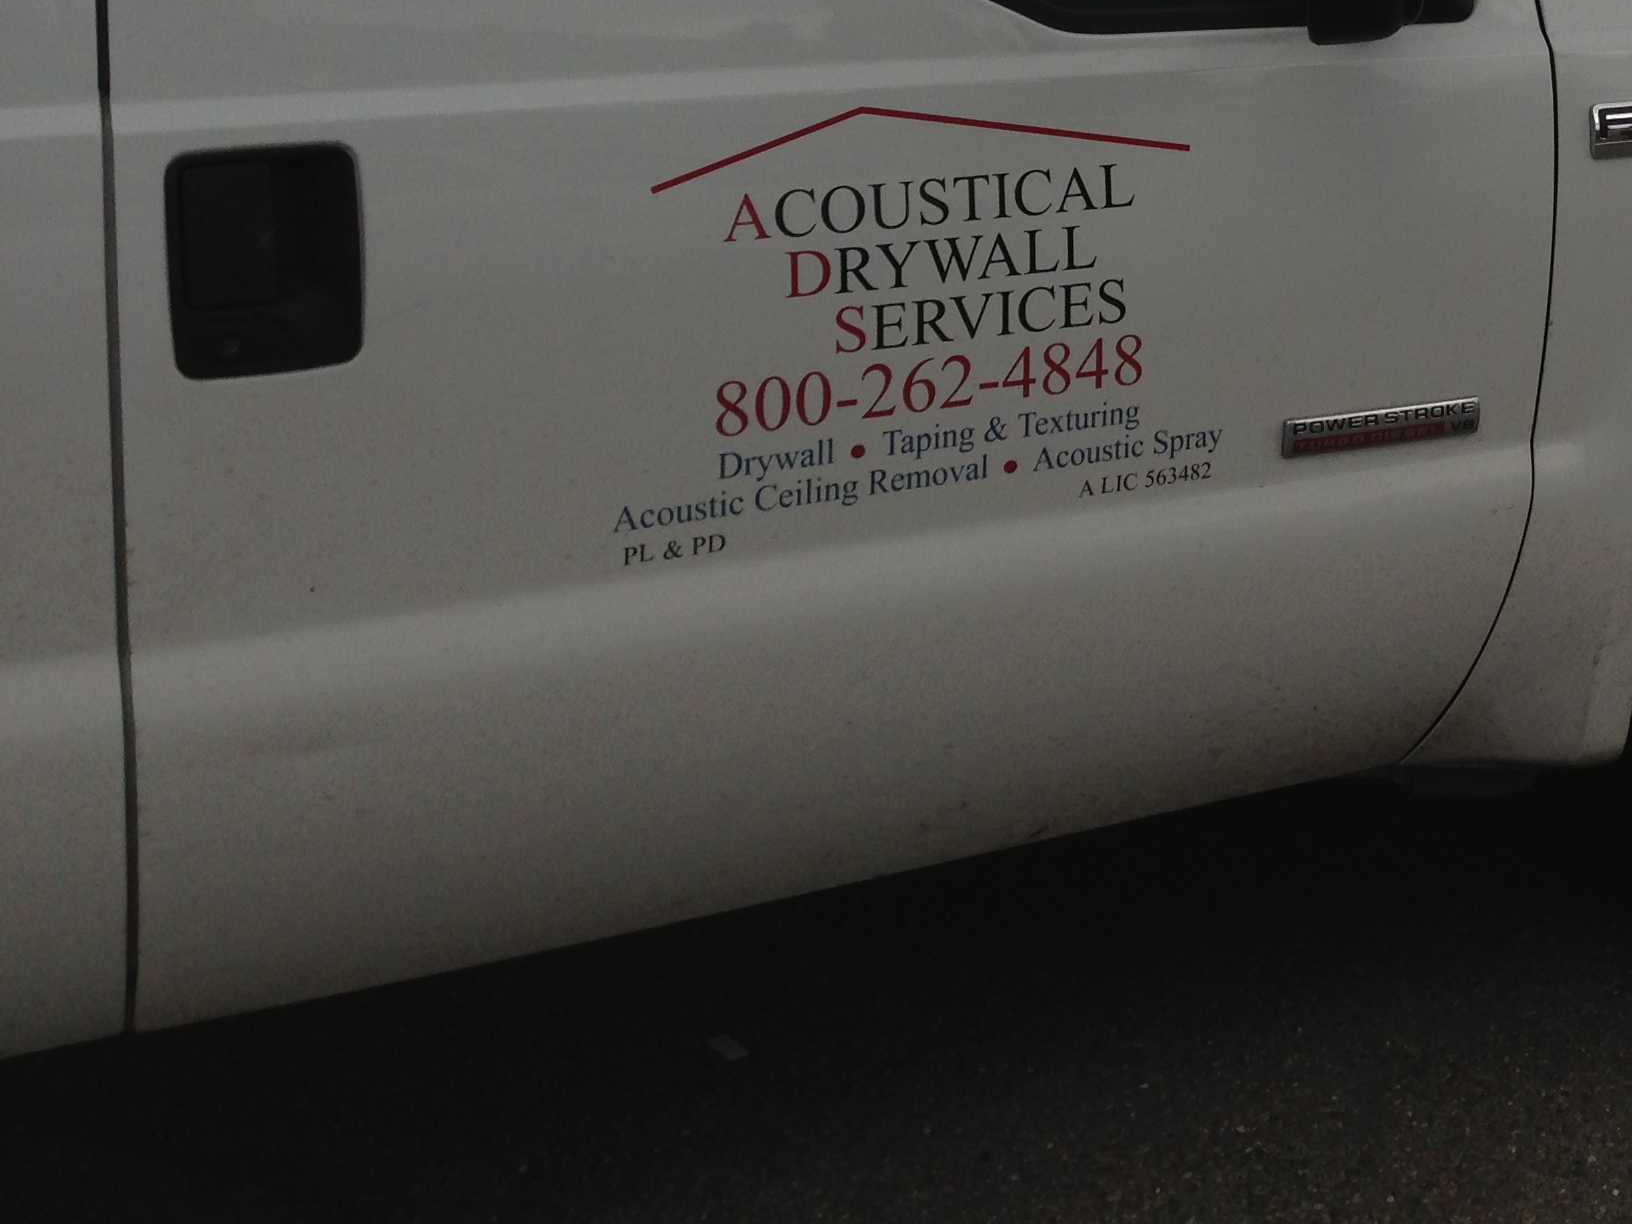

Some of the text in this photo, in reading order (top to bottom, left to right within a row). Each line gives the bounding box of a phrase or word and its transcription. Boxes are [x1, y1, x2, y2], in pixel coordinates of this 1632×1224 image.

[723, 164, 1135, 242] ACOUSTICAL
[783, 225, 1097, 298] DRYWALL
[836, 278, 1126, 354] SERVICES
[715, 334, 1142, 437] 800-262-4848
[718, 402, 1139, 482] Drywall Taping & Texturing
[1450, 419, 1476, 432] V8
[613, 428, 1223, 534] Acoustic Ceiling Removal Acoustic Spray
[1101, 473, 1139, 495] LIC
[1145, 461, 1212, 490] 563482
[623, 533, 727, 567] PL & PD
